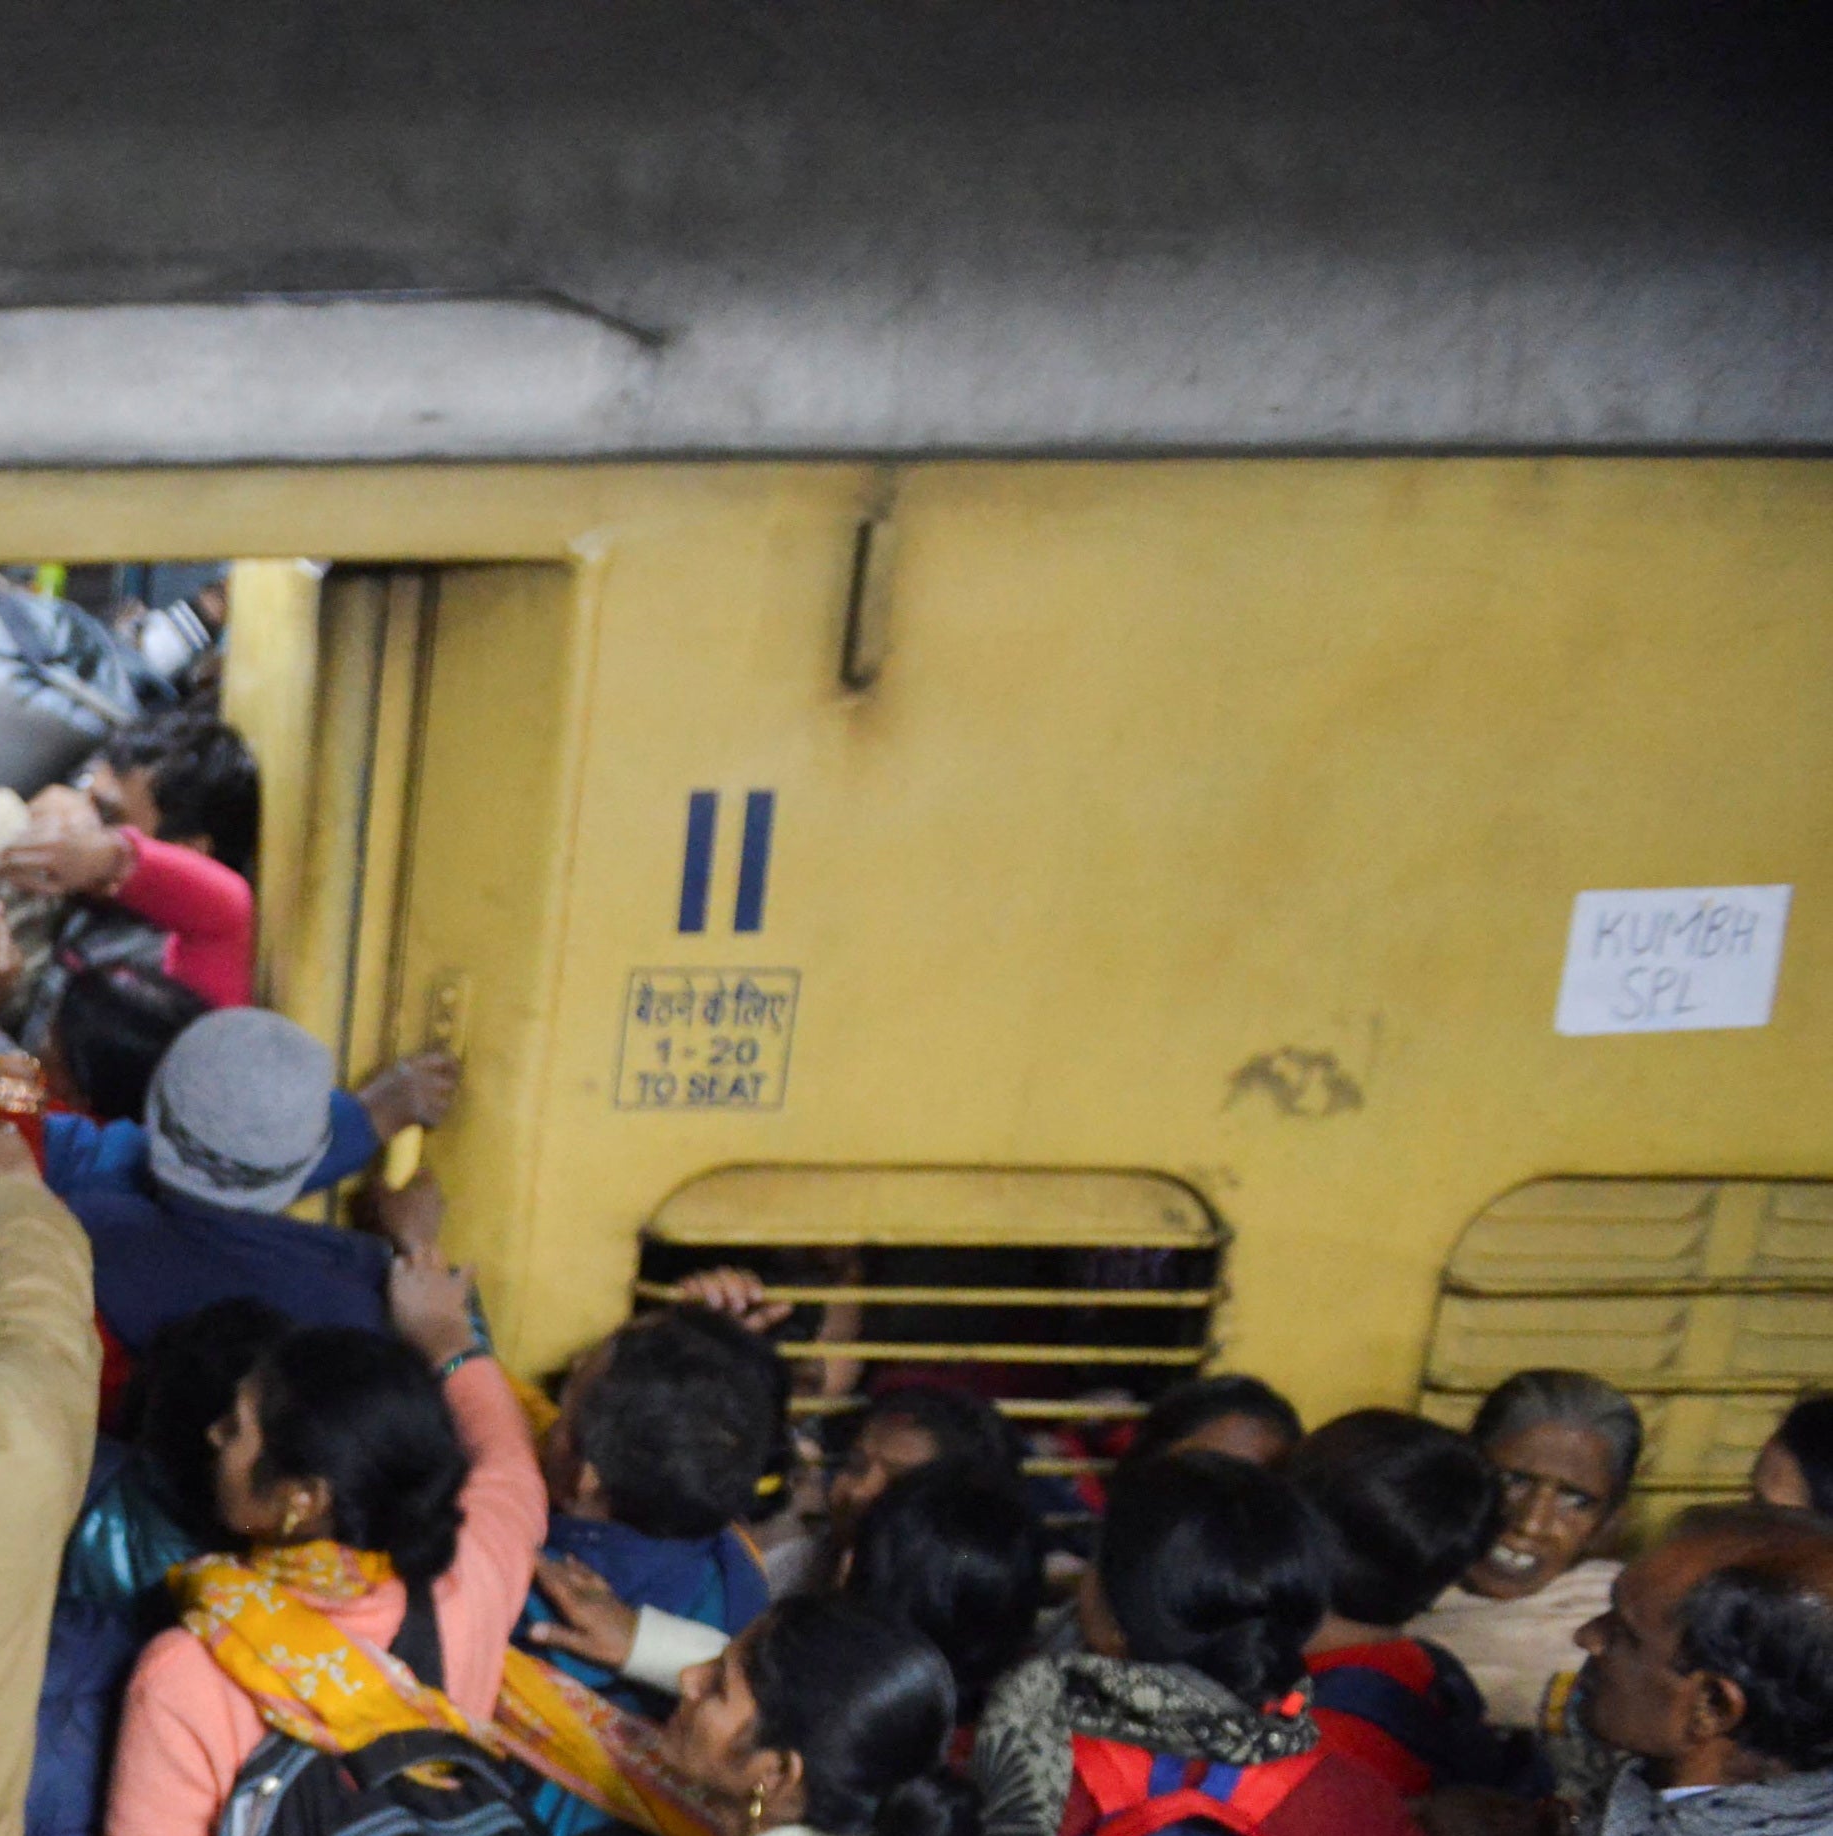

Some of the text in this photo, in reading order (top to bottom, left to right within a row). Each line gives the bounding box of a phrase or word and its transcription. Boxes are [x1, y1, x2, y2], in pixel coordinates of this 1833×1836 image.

[1591, 903, 1761, 960] KUMBH
[1609, 965, 1710, 1022] SPL
[637, 1070, 769, 1106] TO SEAT
